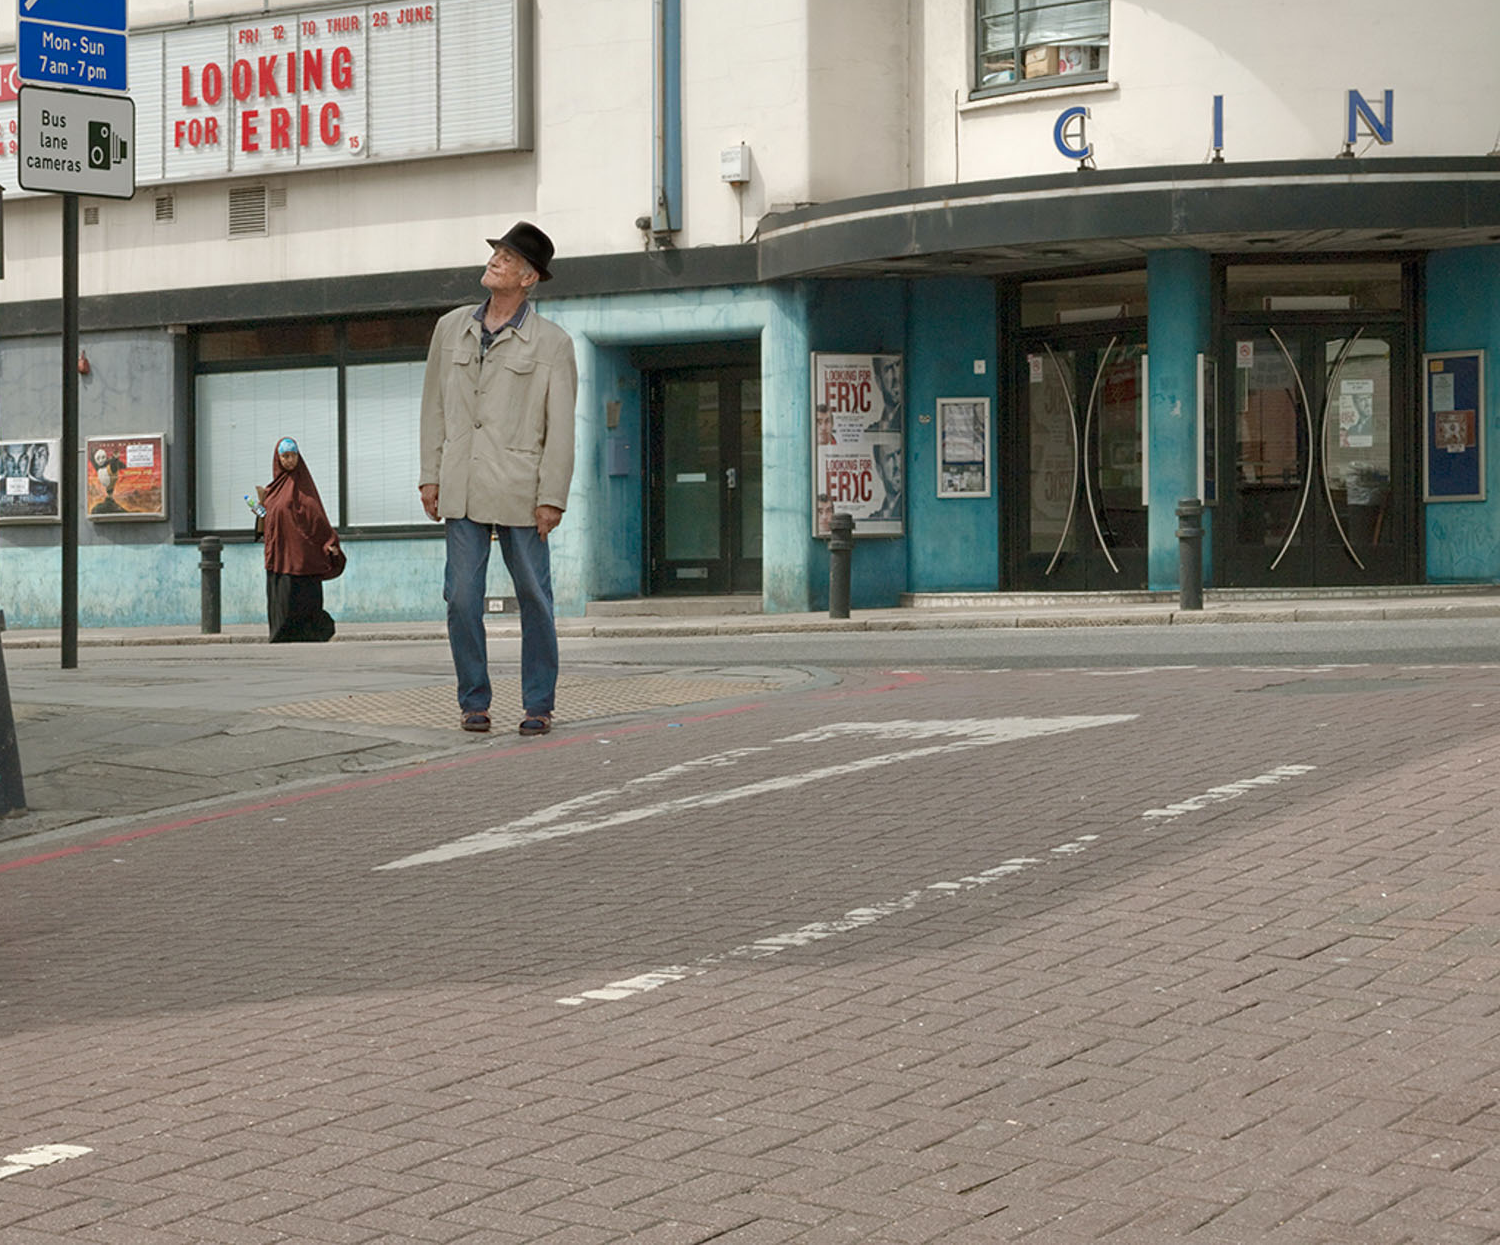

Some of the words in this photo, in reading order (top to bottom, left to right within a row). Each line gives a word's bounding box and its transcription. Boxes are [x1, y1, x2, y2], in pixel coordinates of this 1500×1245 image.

[238, 28, 259, 45] FRI
[271, 25, 285, 41] 12
[301, 20, 317, 36] TO
[326, 15, 360, 33] THUR
[397, 5, 434, 24] JUNE
[181, 46, 353, 107] LOOKING
[41, 110, 67, 129] Bus
[174, 116, 219, 148] FOR
[241, 101, 342, 152] ERIC
[40, 131, 68, 150] lane
[26, 154, 82, 173] cameras
[824, 370, 857, 381] LOOKING
[858, 370, 871, 381] FOR
[824, 381, 871, 413] ERIC
[825, 459, 858, 471] LOOKING
[859, 459, 872, 470] FOR
[826, 470, 873, 503] ERIC
